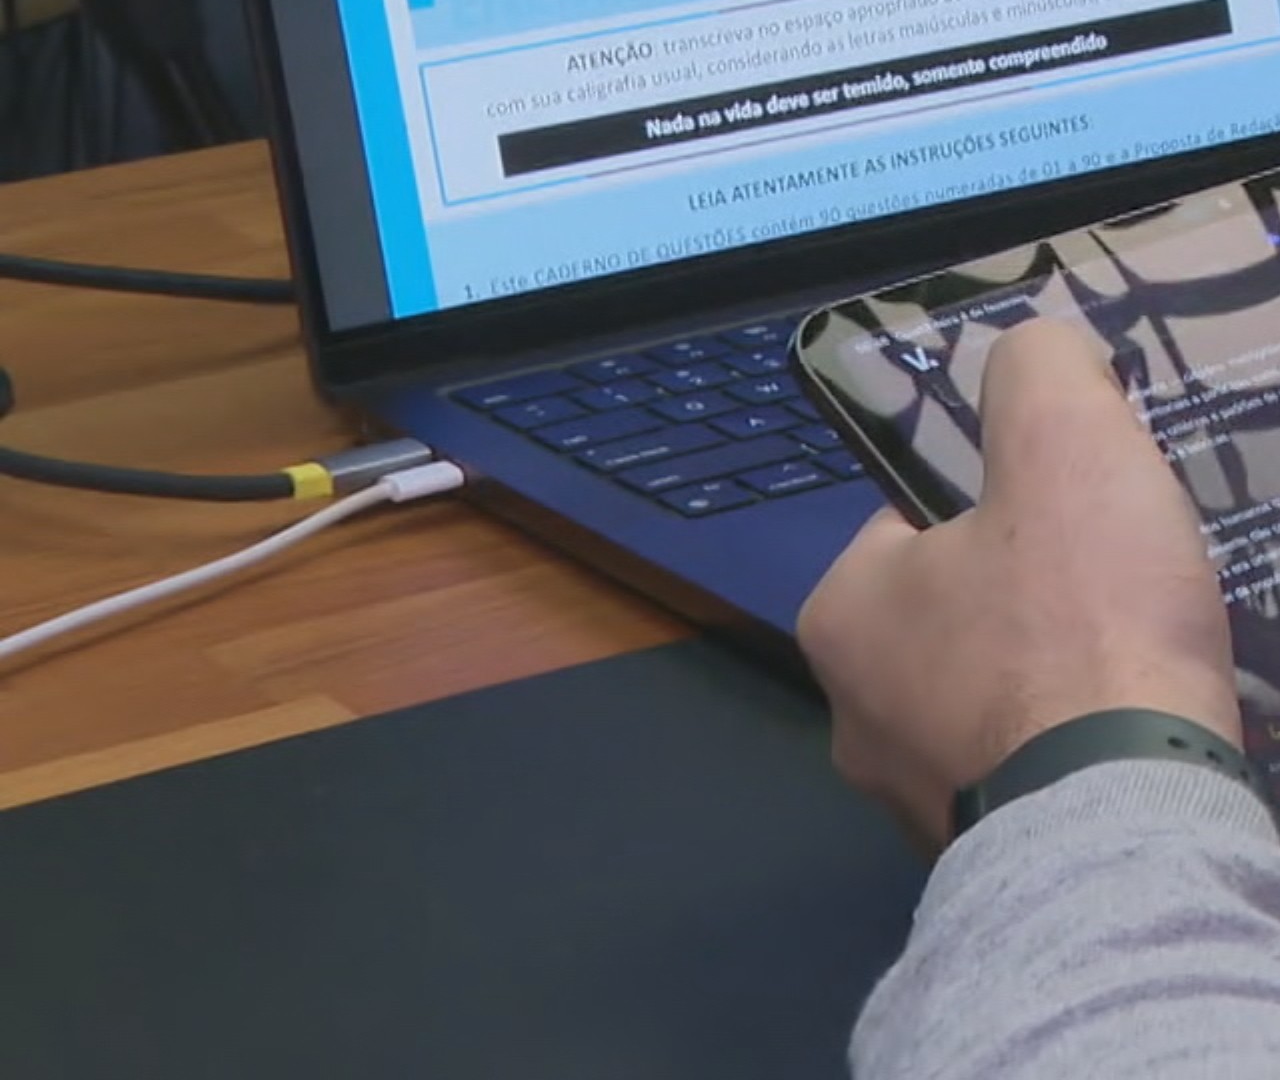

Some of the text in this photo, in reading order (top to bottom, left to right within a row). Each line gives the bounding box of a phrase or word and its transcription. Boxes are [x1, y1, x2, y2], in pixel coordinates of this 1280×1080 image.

[487, 98, 525, 118] com
[531, 90, 562, 108] sua
[567, 73, 647, 104] caligrafia
[652, 62, 702, 87] usual,
[707, 38, 822, 76] considerando
[828, 37, 844, 53] as
[849, 27, 895, 51] letras
[900, 9, 989, 38] maiúsculas
[992, 8, 1002, 19] e
[646, 31, 1108, 139] Nada na vida deve ser temido, somente compreendido
[663, 26, 751, 54] transcreva
[758, 21, 780, 40] no
[785, 9, 842, 32] espaço
[490, 275, 528, 296] Este
[533, 253, 621, 287] CADERNO
[627, 249, 650, 267] DE
[657, 226, 747, 260] QUESTÕES
[752, 214, 815, 239] contém
[819, 205, 841, 223] 90
[846, 193, 920, 223] questões
[925, 172, 1013, 204] numeradas
[1019, 165, 1038, 184] de
[1042, 157, 1061, 175] 01
[1068, 159, 1077, 172] a
[1082, 151, 1101, 168] 90
[1106, 152, 1115, 164] e
[1121, 150, 1130, 162] a
[1135, 132, 1202, 161] Proposta
[1207, 125, 1225, 142] de
[689, 187, 727, 211] LEIA
[731, 162, 859, 203] ATENTAMENTE
[864, 157, 887, 176] AS
[891, 133, 995, 170] INSTRUÇÕES
